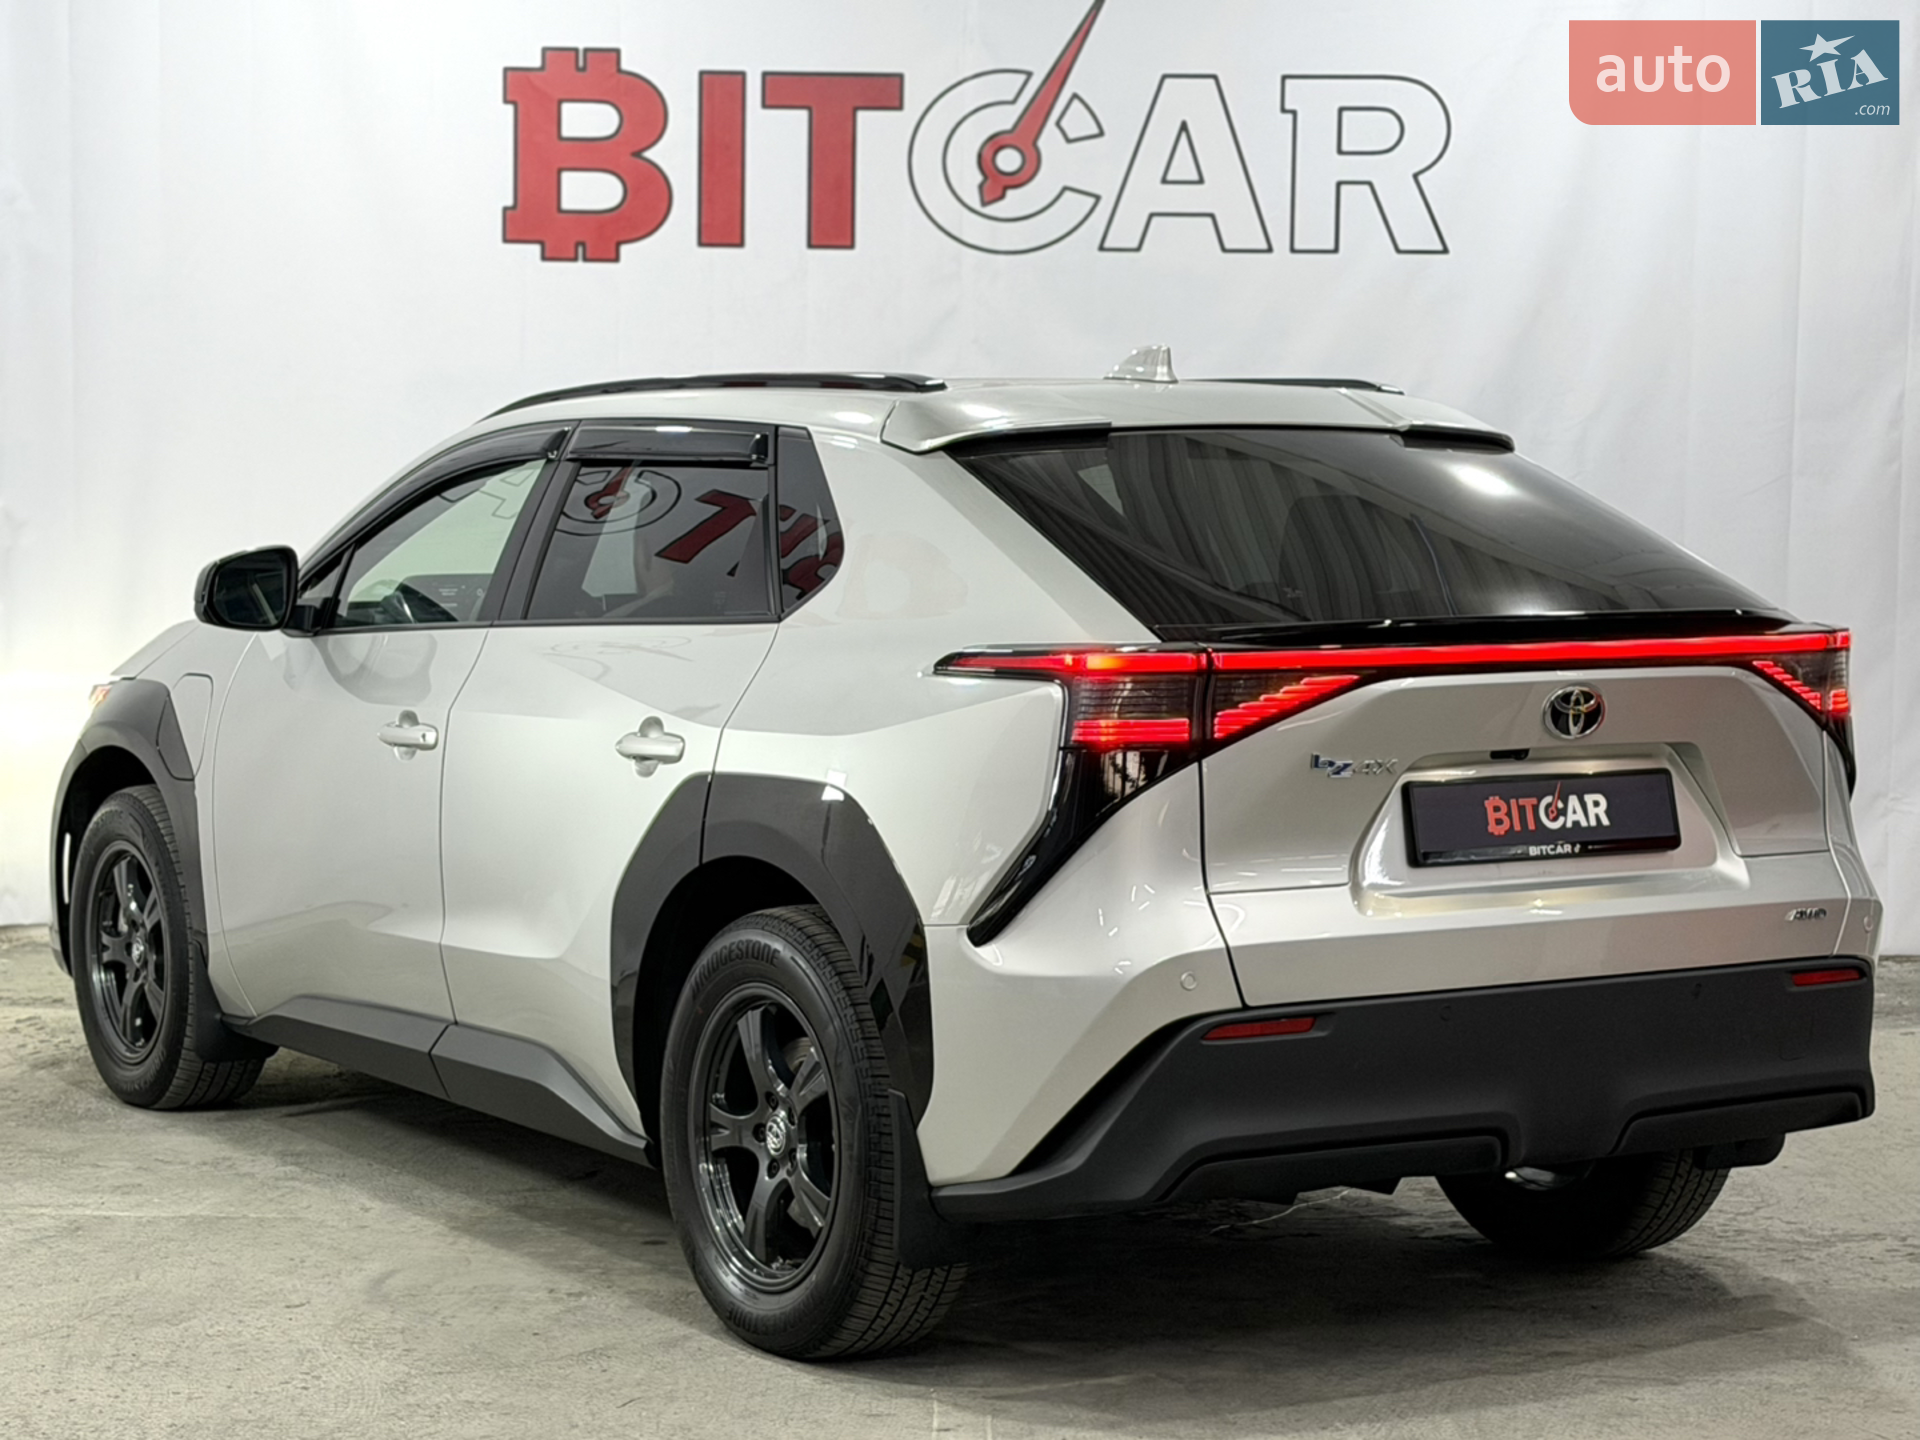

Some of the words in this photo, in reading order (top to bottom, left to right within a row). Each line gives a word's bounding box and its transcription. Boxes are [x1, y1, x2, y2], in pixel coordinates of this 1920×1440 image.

[502, 46, 1450, 262] BITCAR
[1484, 792, 1610, 836] BITCAR
[1528, 843, 1572, 856] BITCAR
